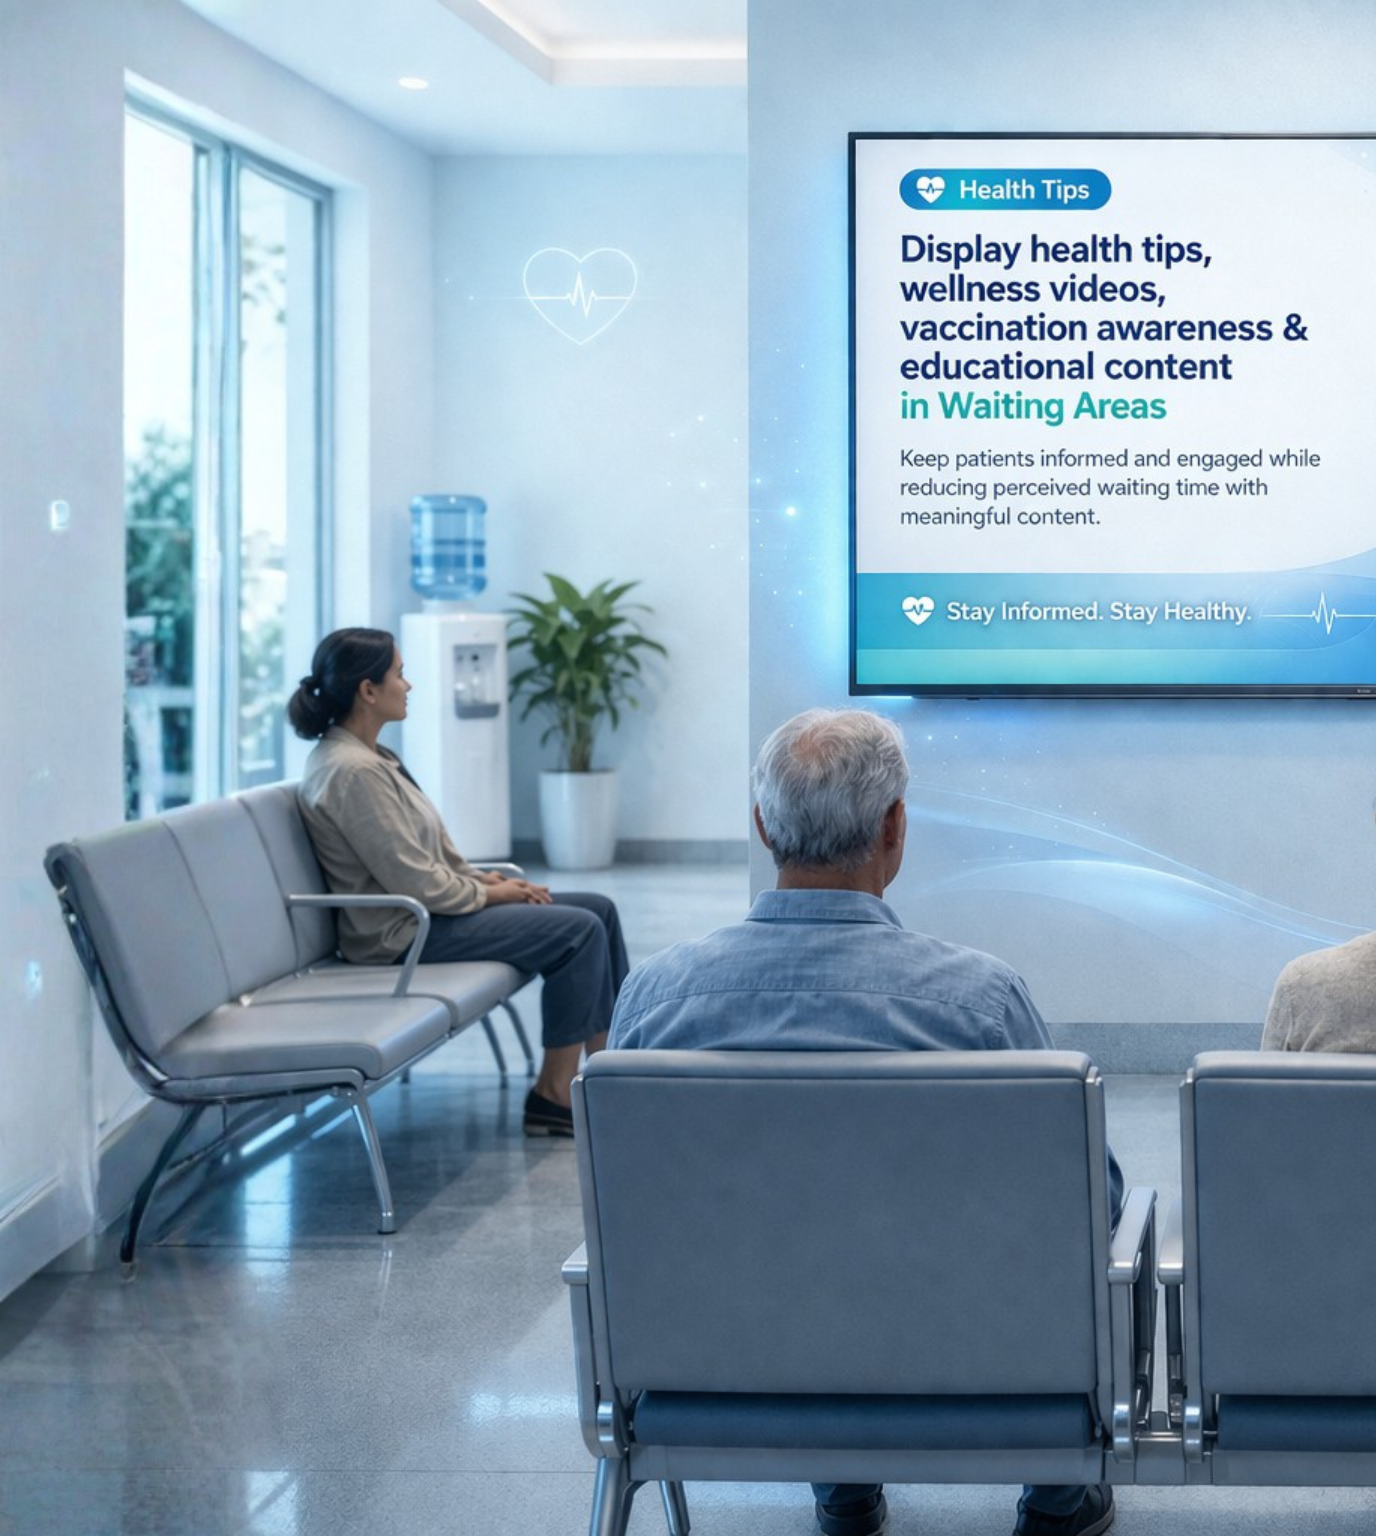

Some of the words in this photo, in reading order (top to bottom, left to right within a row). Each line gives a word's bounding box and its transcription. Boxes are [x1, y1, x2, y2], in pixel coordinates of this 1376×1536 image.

[959, 178, 1036, 200] Health
[1041, 178, 1090, 204] Tips
[901, 234, 1022, 270] Display
[1031, 233, 1133, 263] health
[1141, 234, 1212, 270] tips,
[900, 272, 1041, 303] wellness
[1049, 272, 1166, 308] videos,
[900, 311, 1088, 342] vaccination
[1096, 320, 1274, 342] awareness
[1283, 312, 1309, 342] &
[900, 350, 1094, 380] educational
[1104, 353, 1233, 380] content
[900, 390, 929, 420] in
[937, 390, 1064, 427] Waiting
[1073, 391, 1167, 420] Areas
[900, 449, 950, 472] Keep
[955, 449, 1035, 472] patients
[1040, 448, 1129, 468] informed
[1134, 448, 1171, 467] and
[1176, 448, 1263, 472] engaged
[1269, 448, 1321, 468] while
[900, 477, 987, 501] reducing
[993, 477, 1091, 501] perceived
[1097, 477, 1170, 501] waiting
[1175, 478, 1220, 496] time
[1225, 477, 1268, 496] with
[900, 506, 1011, 530] meaningful
[1017, 508, 1101, 526] content.
[947, 602, 995, 625] Stay
[1002, 600, 1104, 620] Informed.
[1110, 601, 1159, 625] Stay
[1164, 601, 1251, 625] Healthy.
